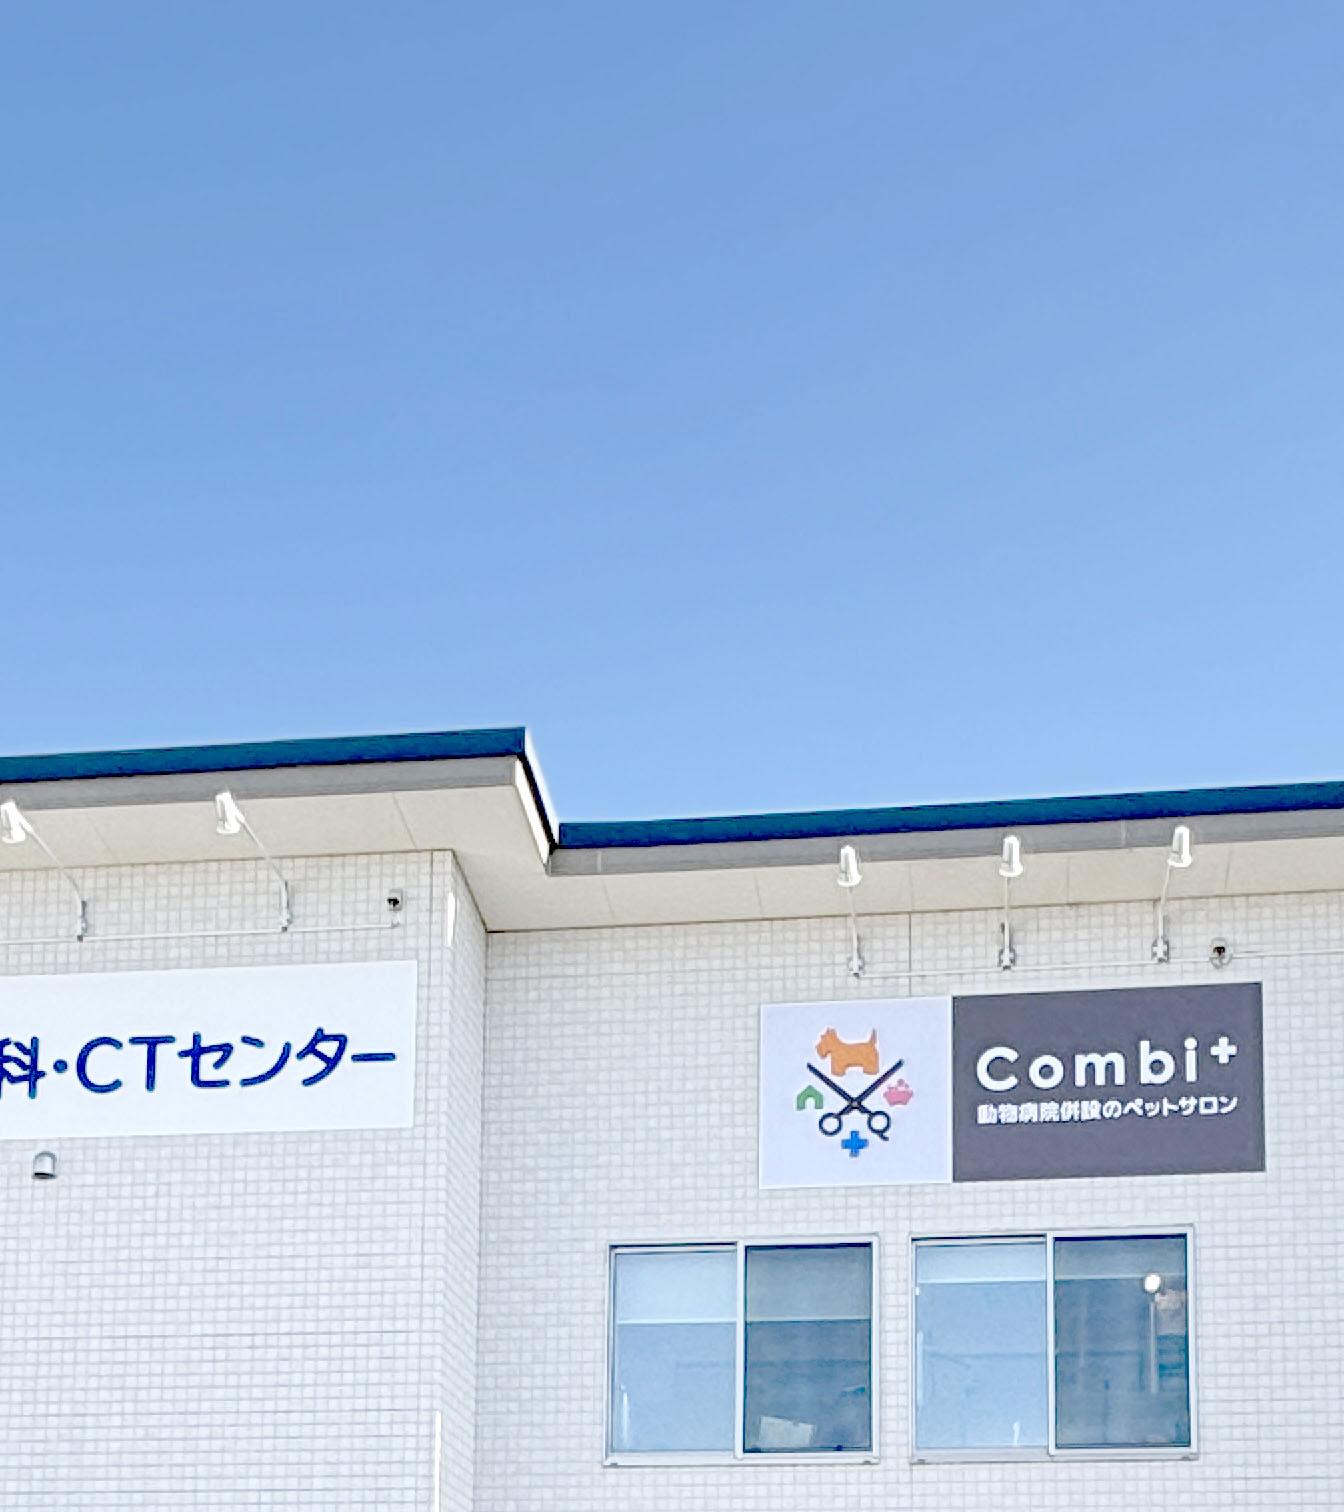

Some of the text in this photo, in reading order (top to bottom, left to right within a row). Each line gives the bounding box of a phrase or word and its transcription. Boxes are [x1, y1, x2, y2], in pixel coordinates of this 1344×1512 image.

[976, 1095, 1238, 1125] 動物病院併設のペットサロン
